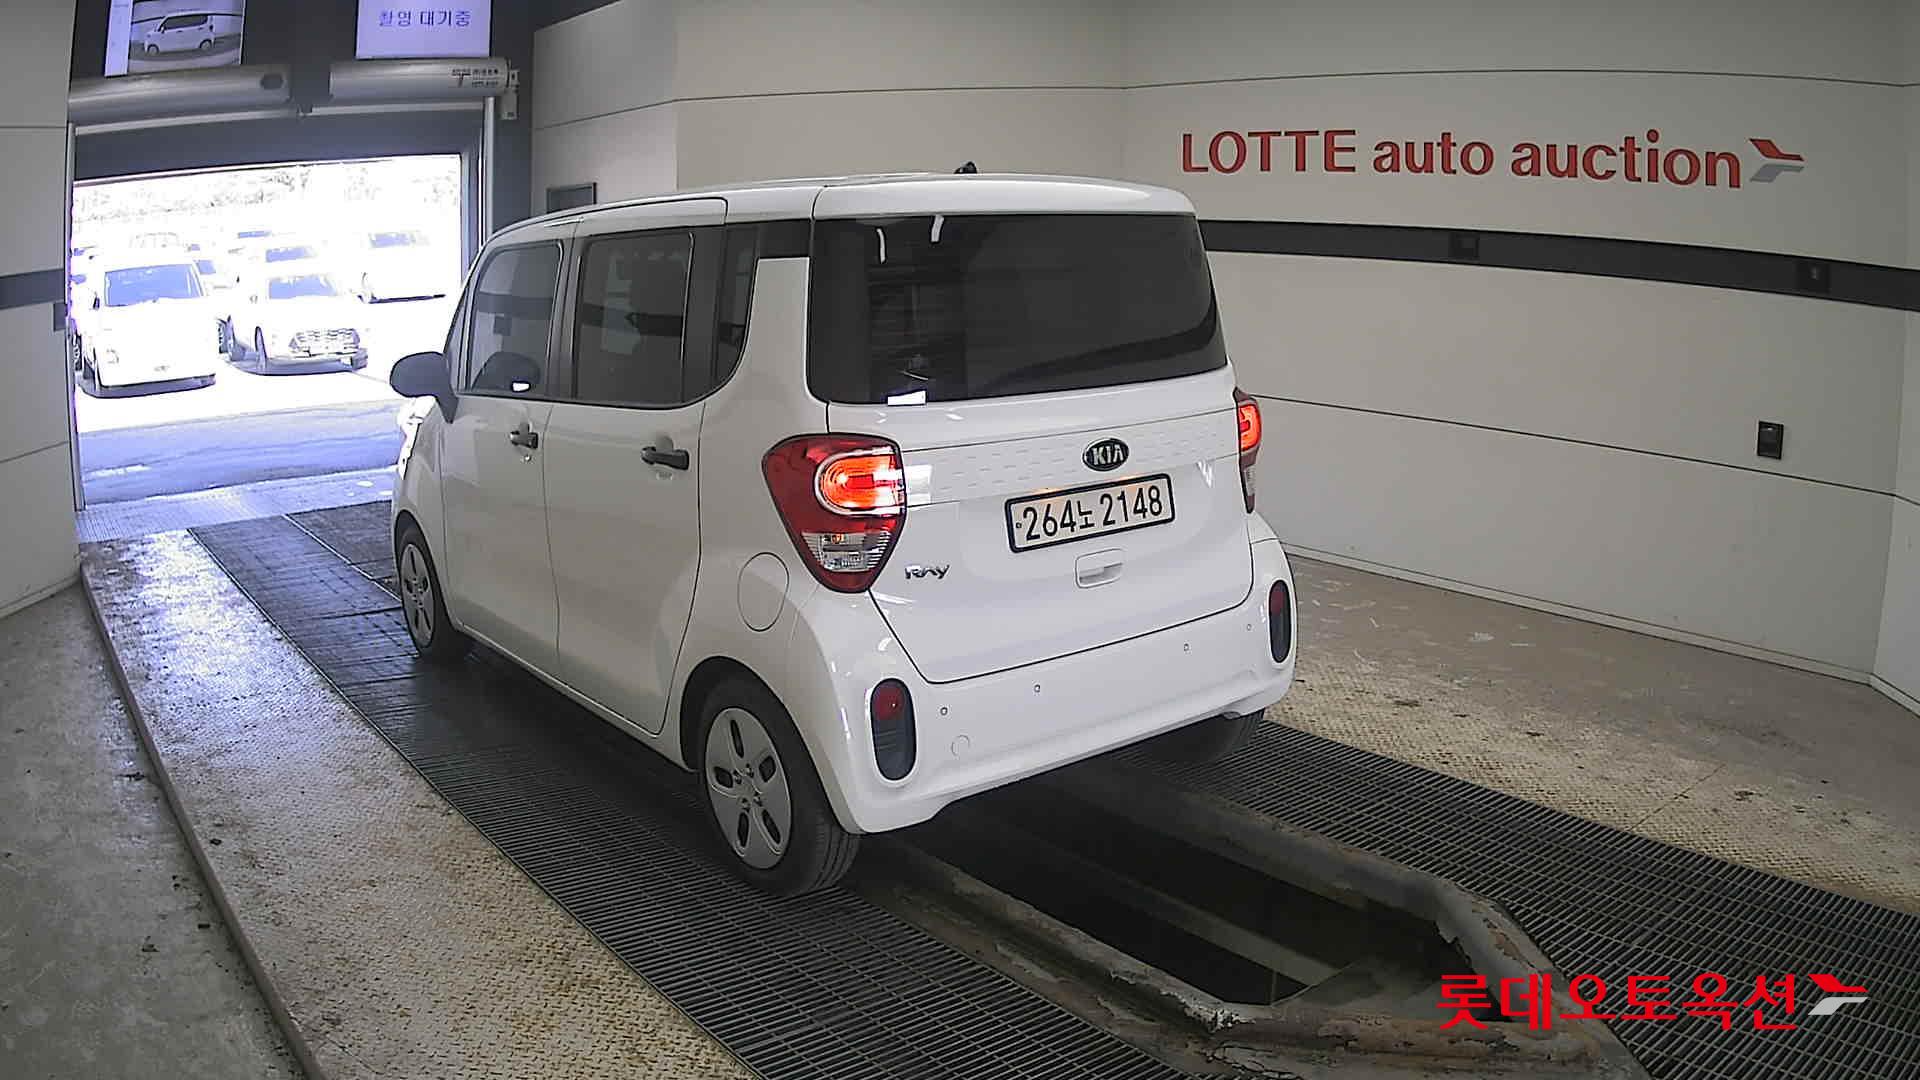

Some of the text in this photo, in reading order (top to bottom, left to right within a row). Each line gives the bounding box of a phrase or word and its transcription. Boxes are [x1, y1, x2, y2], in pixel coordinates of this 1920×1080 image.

[419, 10, 471, 27] 대기중
[1182, 128, 1742, 189] LOTTE auto auction
[1088, 442, 1127, 467] KIA
